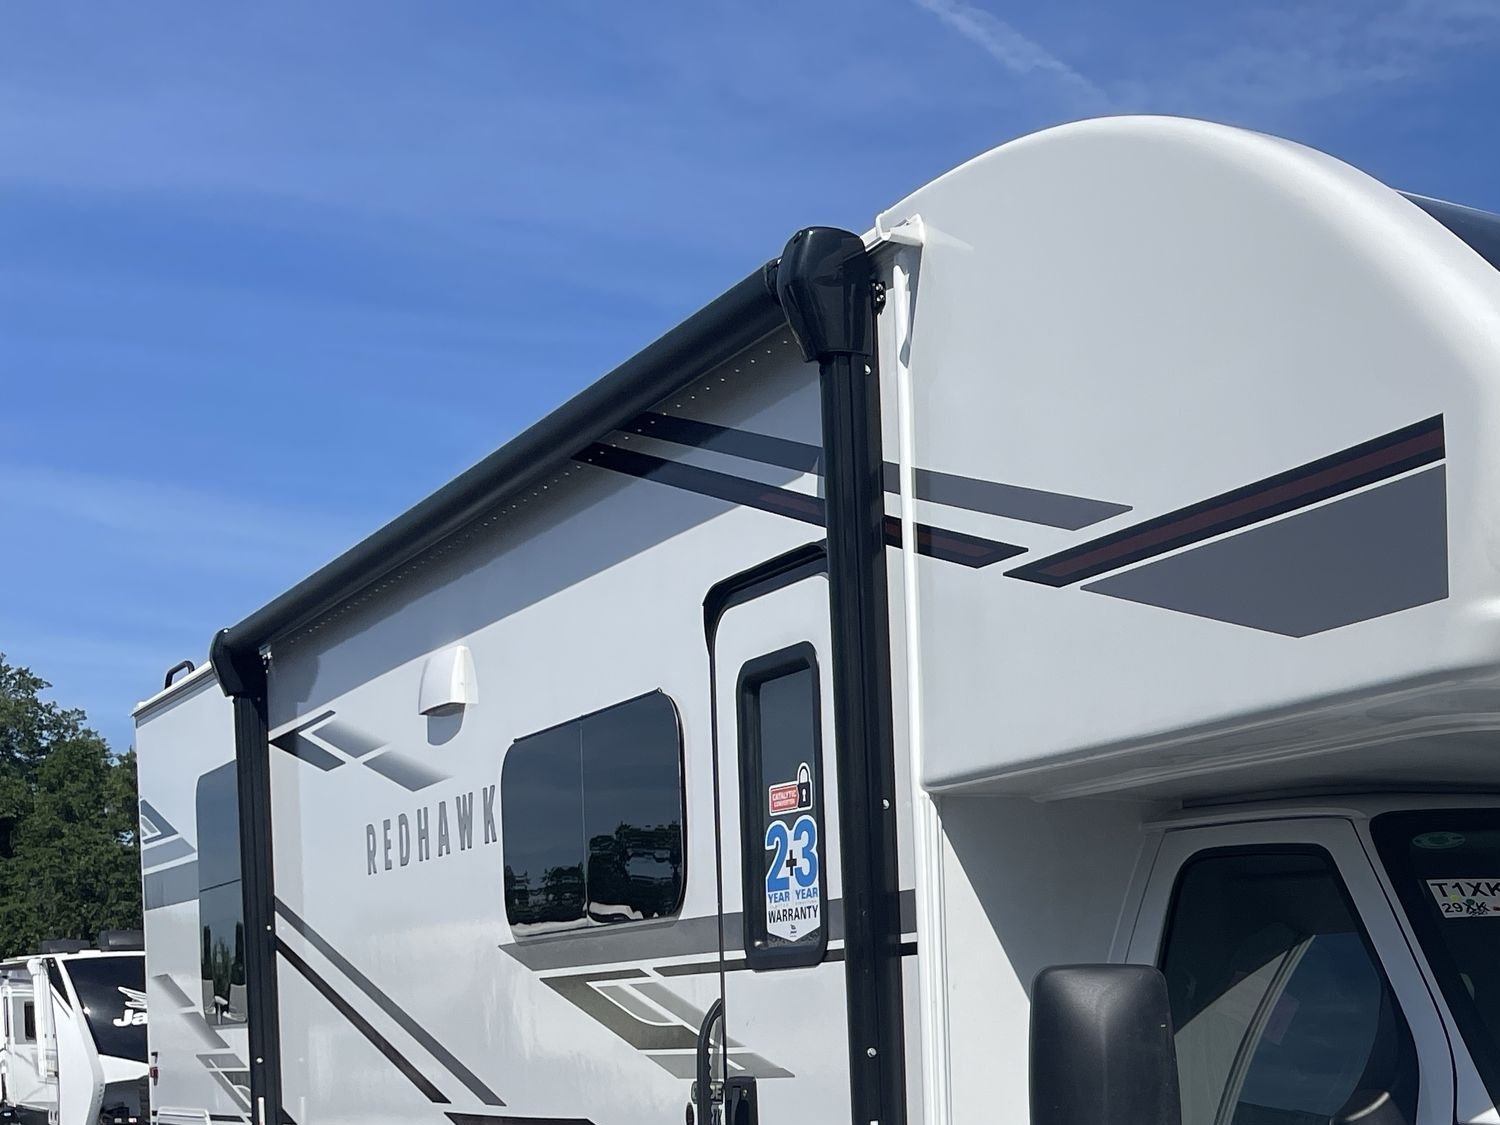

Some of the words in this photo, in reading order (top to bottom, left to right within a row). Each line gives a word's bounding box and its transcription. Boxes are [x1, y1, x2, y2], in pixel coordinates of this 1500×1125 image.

[366, 785, 498, 876] REDHAWK
[768, 892, 790, 903] YEAR
[795, 888, 818, 900] YEAR
[768, 905, 818, 924] WARRANTY
